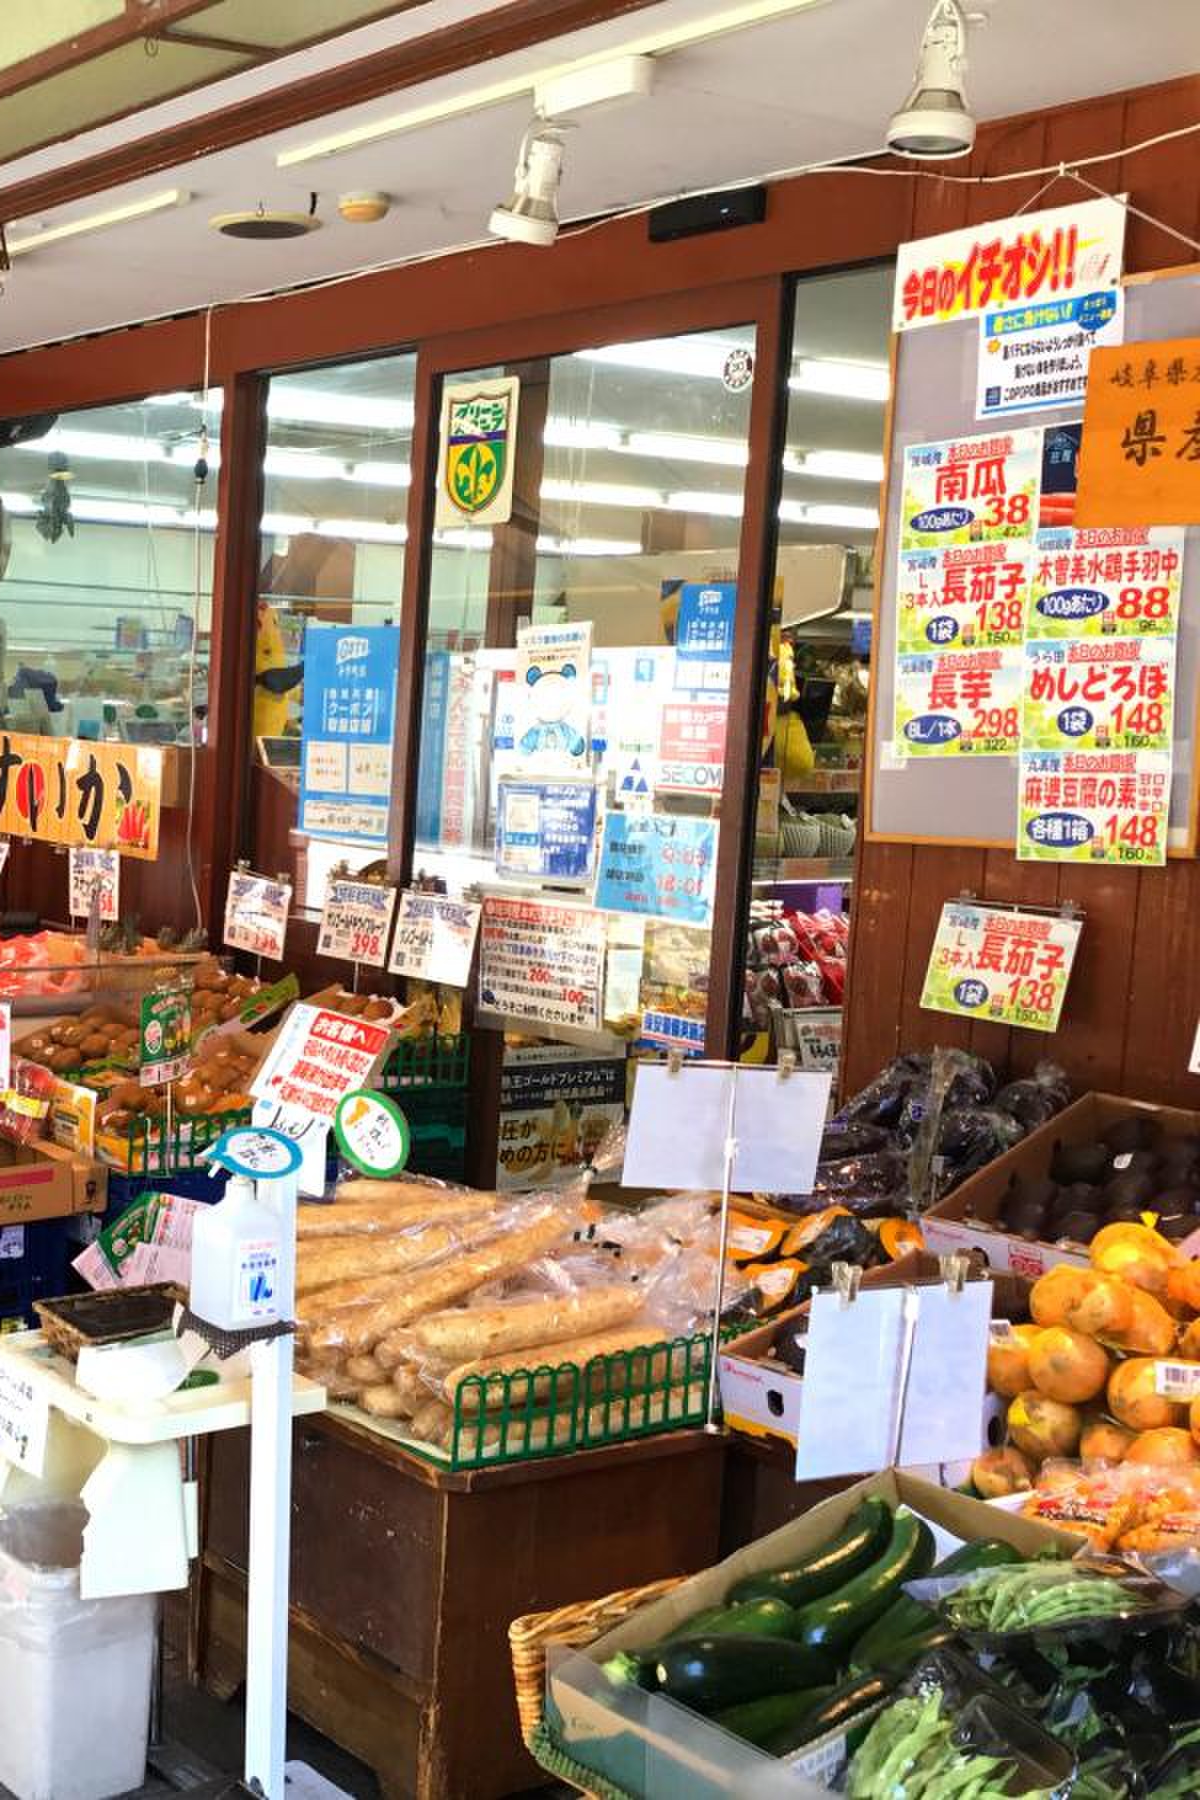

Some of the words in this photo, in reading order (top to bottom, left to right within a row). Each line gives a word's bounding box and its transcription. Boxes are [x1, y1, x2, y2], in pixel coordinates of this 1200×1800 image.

[935, 458, 1007, 504] 南瓜
[983, 494, 1030, 527] 38
[919, 575, 928, 588] L
[941, 562, 1027, 606] 長茄子
[905, 591, 943, 610] 3本入
[976, 602, 1023, 631] 138
[1042, 592, 1104, 618] 100gあたり
[1115, 586, 1171, 619] 88
[928, 672, 993, 710] 長芋
[1029, 662, 1170, 702] めしどろぼ
[328, 702, 374, 717] クーポン
[972, 708, 1019, 739] 298
[1062, 711, 1088, 733] 1袋
[1110, 703, 1164, 735] 148
[659, 764, 722, 787] SECOM
[1024, 776, 1137, 810] 麻婆豆腐の素
[1031, 816, 1090, 842] 各種1箱
[1105, 815, 1158, 848] 148
[351, 930, 380, 957] 398
[976, 934, 1065, 980] 長茄子
[1007, 977, 1057, 1013] 138
